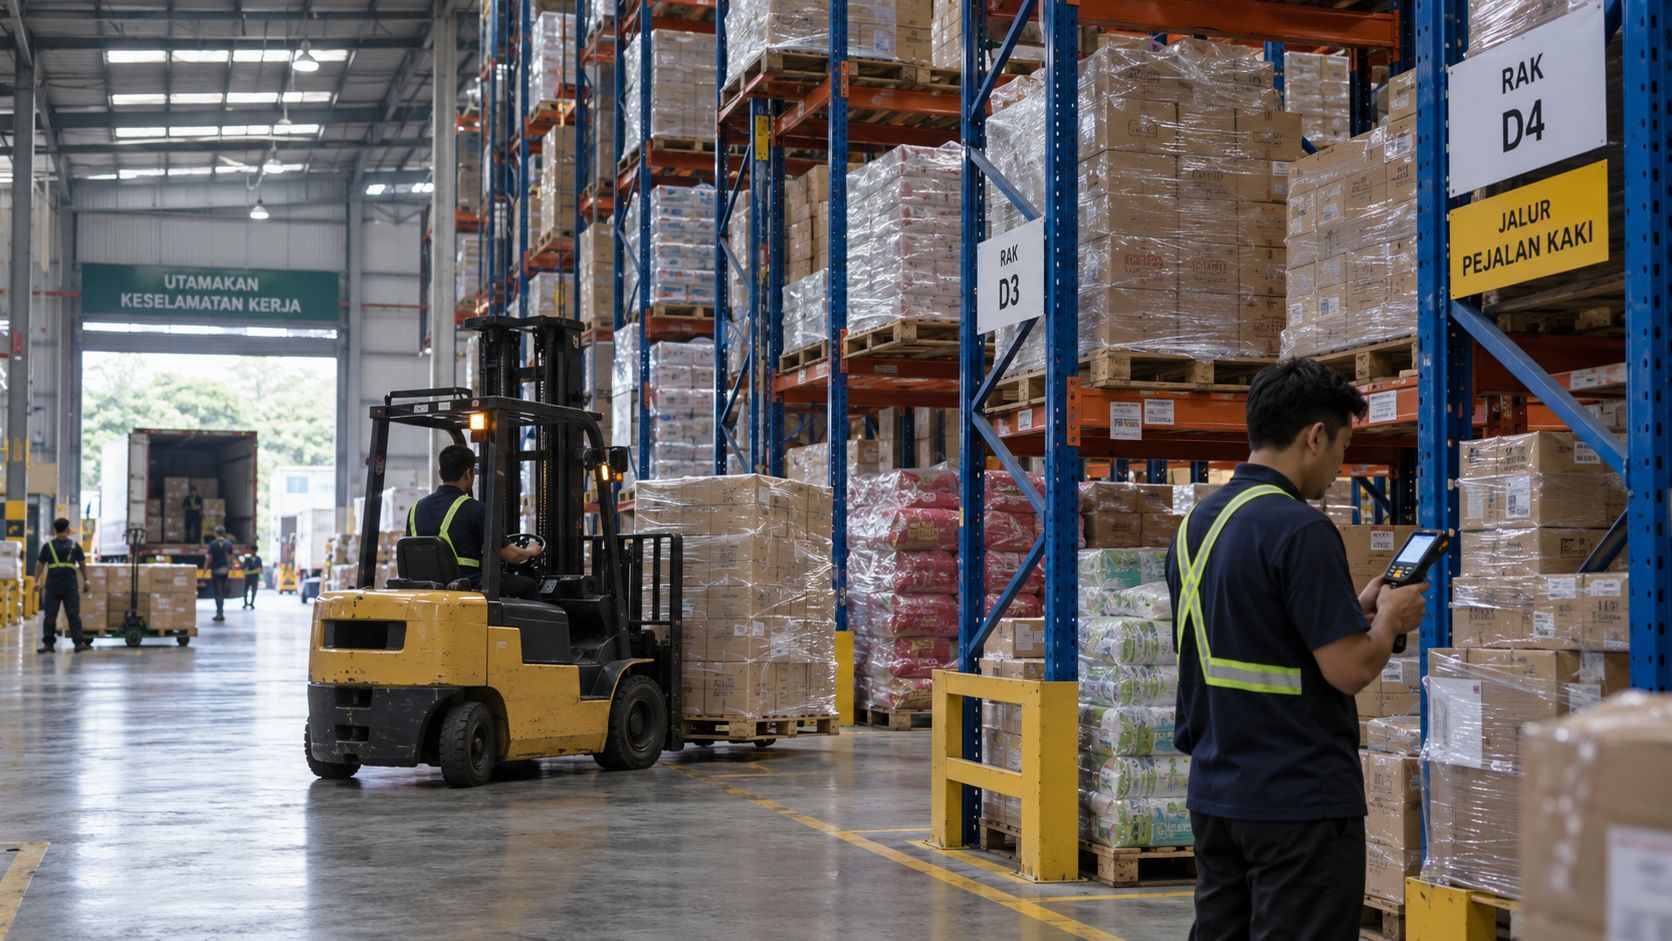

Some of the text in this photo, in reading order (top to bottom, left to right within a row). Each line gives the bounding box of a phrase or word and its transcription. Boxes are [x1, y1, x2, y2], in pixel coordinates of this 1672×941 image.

[1502, 53, 1544, 94] RAK
[1502, 98, 1545, 153] D4
[1498, 199, 1551, 233] JALUR
[1000, 244, 1018, 267] RAK
[1462, 220, 1593, 277] PEJALAN KAKI
[164, 274, 259, 292] UTAMAKAN
[999, 273, 1019, 310] D3
[121, 293, 302, 313] KESELAMATAN KERJA
